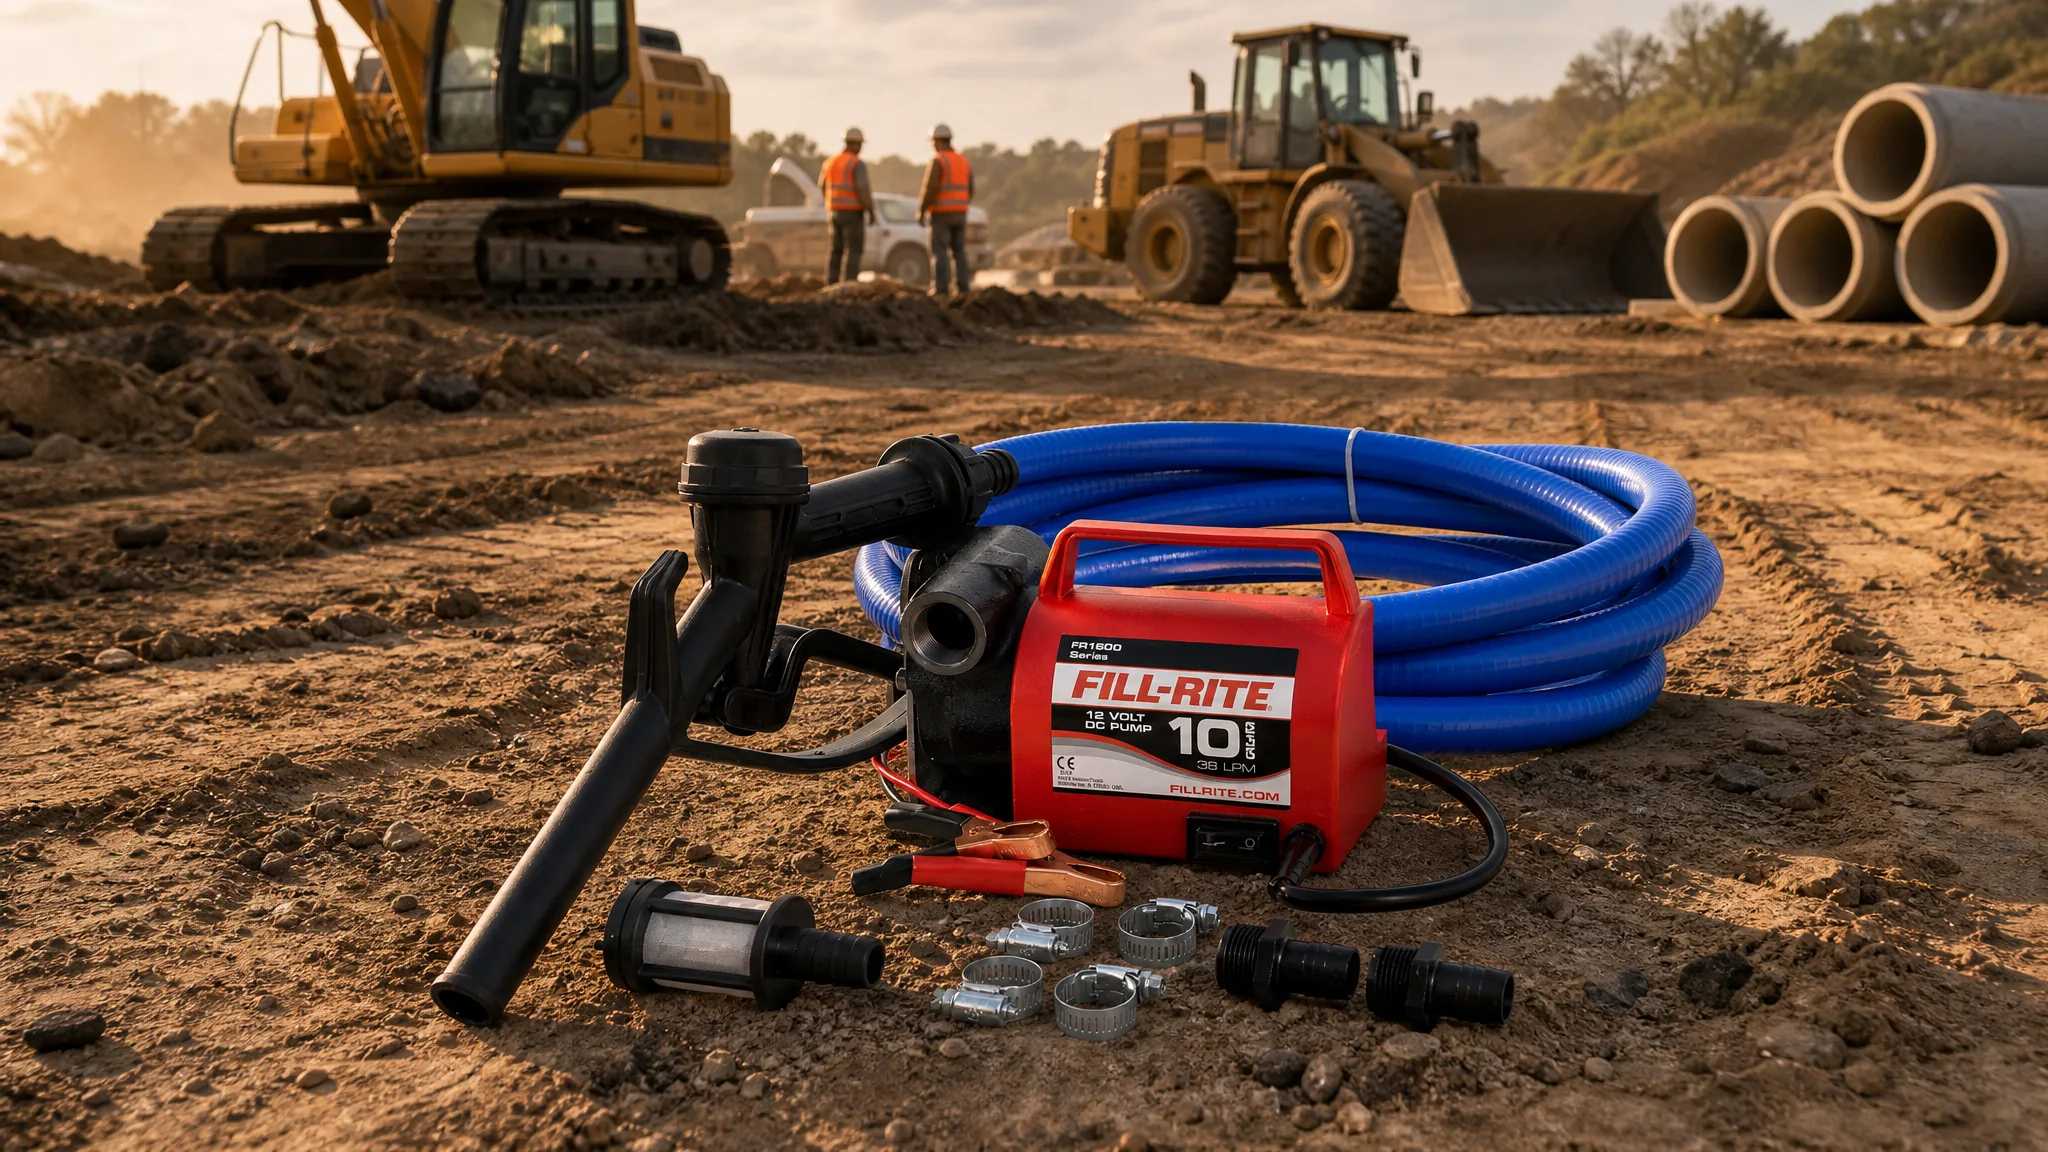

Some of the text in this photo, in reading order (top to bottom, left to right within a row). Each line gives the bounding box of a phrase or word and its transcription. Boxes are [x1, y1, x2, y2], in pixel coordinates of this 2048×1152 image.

[1071, 641, 1122, 651] FR1600
[1071, 670, 1274, 711] FILL-RITE
[1086, 711, 1145, 722] 12 VOLT
[1085, 721, 1152, 733] DC PUMP
[1168, 716, 1240, 758] 10
[1197, 760, 1256, 773] 38 LPM
[1169, 784, 1280, 801] FILLRITE.COM
